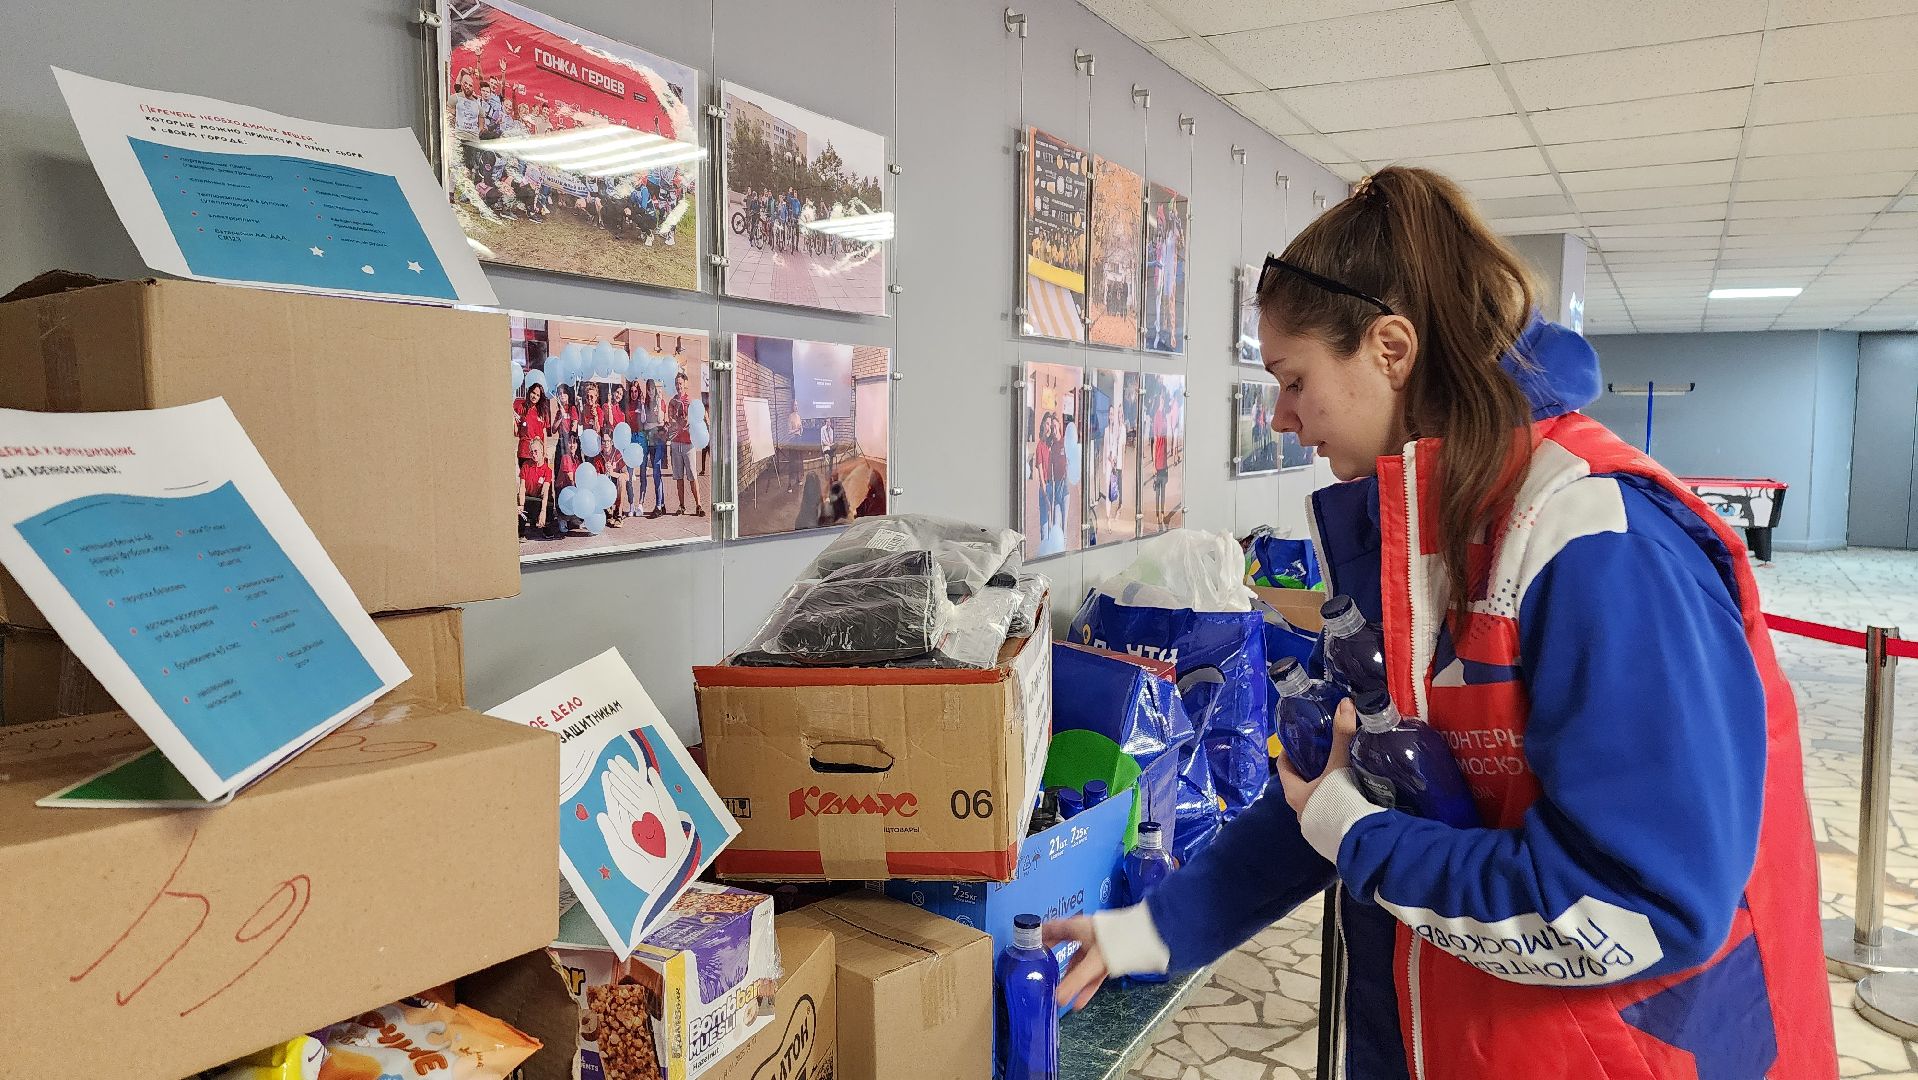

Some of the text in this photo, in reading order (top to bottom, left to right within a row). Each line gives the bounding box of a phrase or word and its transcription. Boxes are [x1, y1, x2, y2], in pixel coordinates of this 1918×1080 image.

[535, 47, 625, 95] ГОНКА ГЕРОЕВ
[144, 115, 196, 129] КОТОРЫЕ
[200, 124, 241, 135] МОЖНО
[244, 130, 293, 145] ПРИНЕСТИ
[304, 143, 331, 154] ПУНКТ
[161, 128, 198, 138] СВОЕМ
[550, 696, 583, 722] ДЕЛО
[560, 700, 623, 743] ЗАЩИТНИКАМ
[951, 789, 994, 820] 06
[689, 1012, 737, 1061] MUESLI
[692, 1046, 720, 1071] Hazelnut
